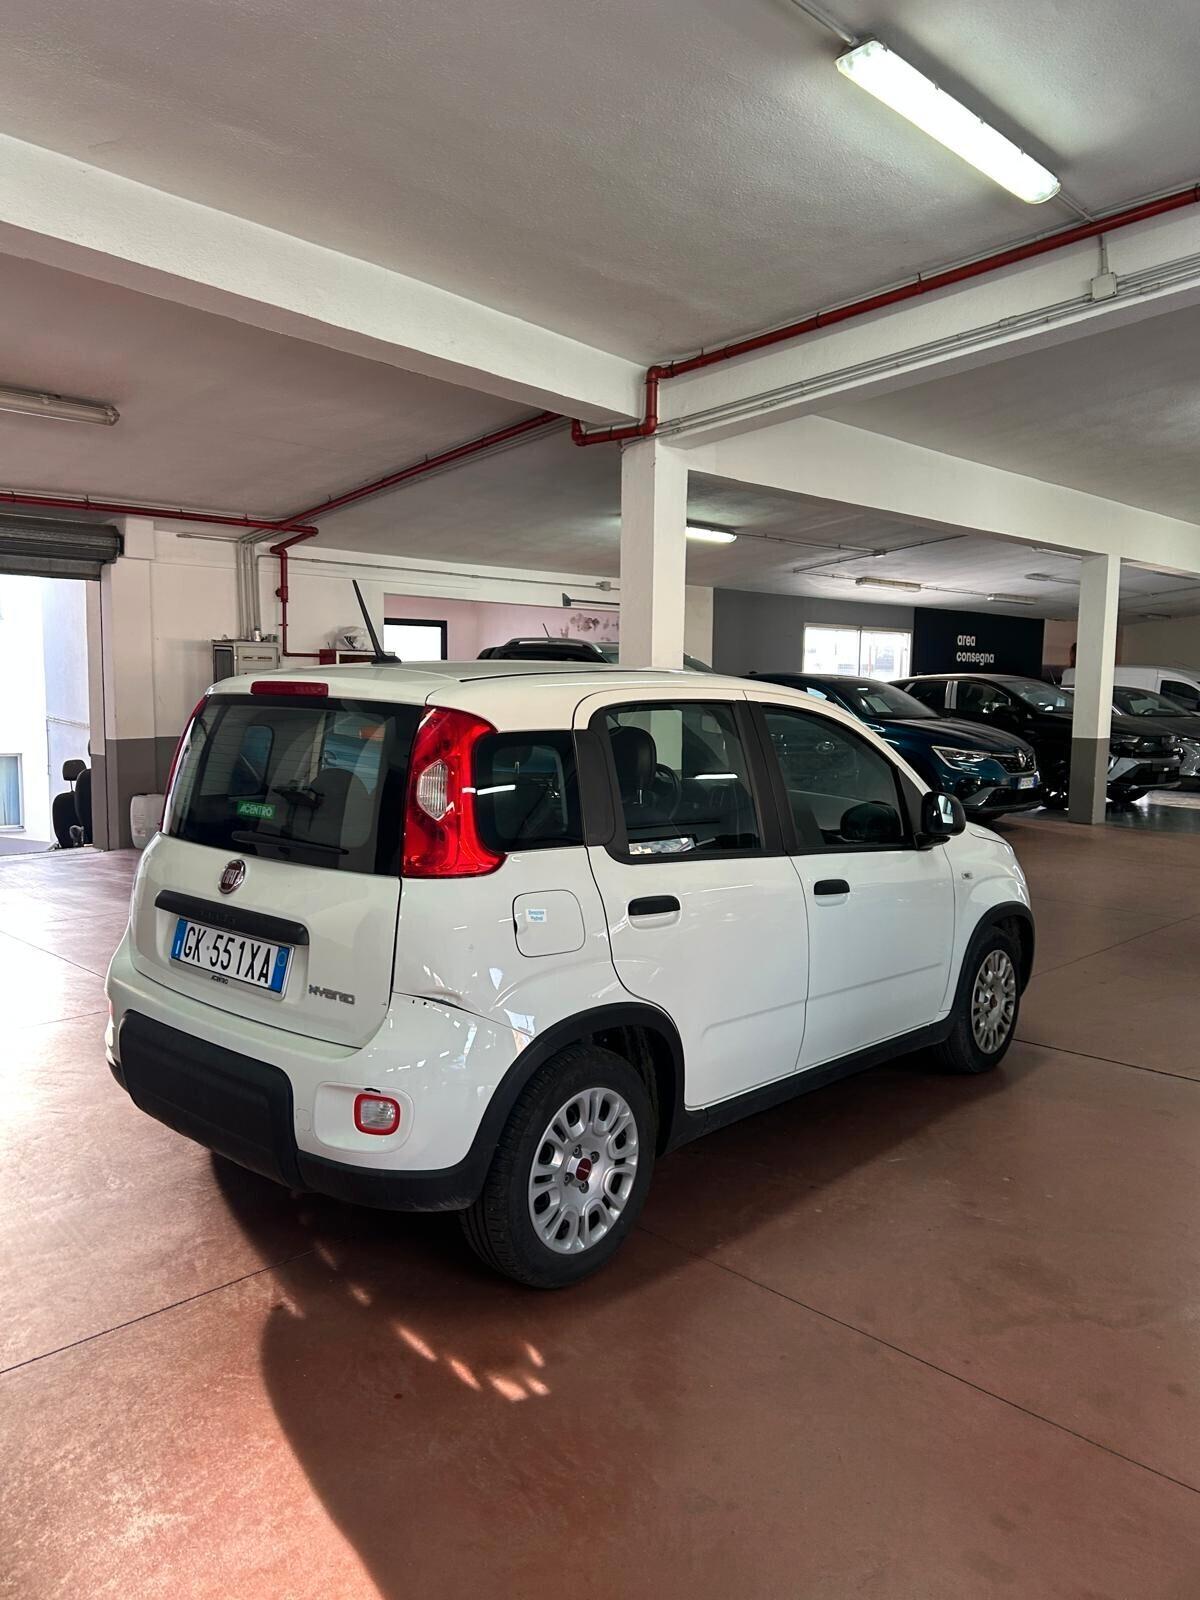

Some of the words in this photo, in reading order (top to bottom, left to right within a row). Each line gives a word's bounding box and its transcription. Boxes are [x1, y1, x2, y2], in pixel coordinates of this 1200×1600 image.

[957, 635, 976, 646] area
[956, 652, 995, 666] consegna
[240, 803, 273, 817] ACENTRO
[222, 868, 240, 885] FIAT
[184, 926, 206, 962] GK
[209, 934, 271, 984] 551XA
[309, 984, 356, 1006] HYBRID
